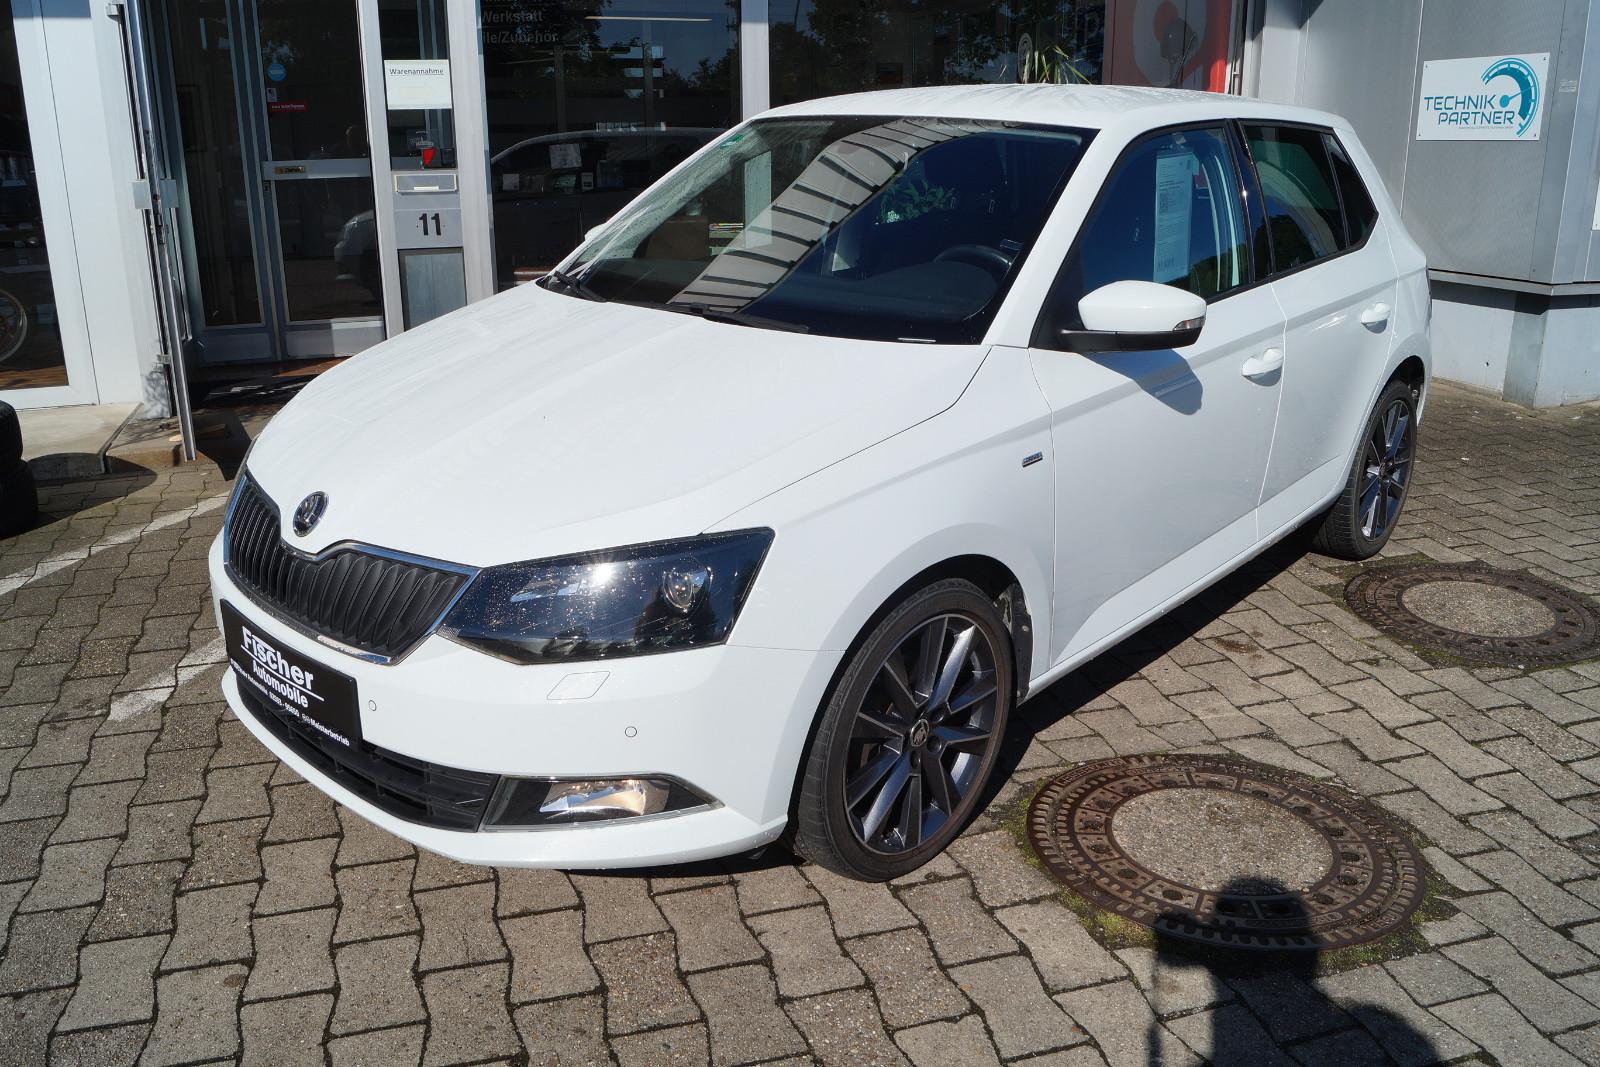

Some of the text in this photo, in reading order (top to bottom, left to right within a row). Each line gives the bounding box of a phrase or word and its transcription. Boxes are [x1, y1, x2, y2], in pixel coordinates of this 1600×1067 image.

[482, 10, 544, 23] Werkstatt
[390, 67, 444, 75] Warenannahme
[1424, 94, 1497, 111] TECHNIK
[1438, 110, 1515, 125] PARTNER
[419, 213, 441, 236] 11
[242, 626, 314, 690] Fischer
[253, 659, 309, 707] Automobile
